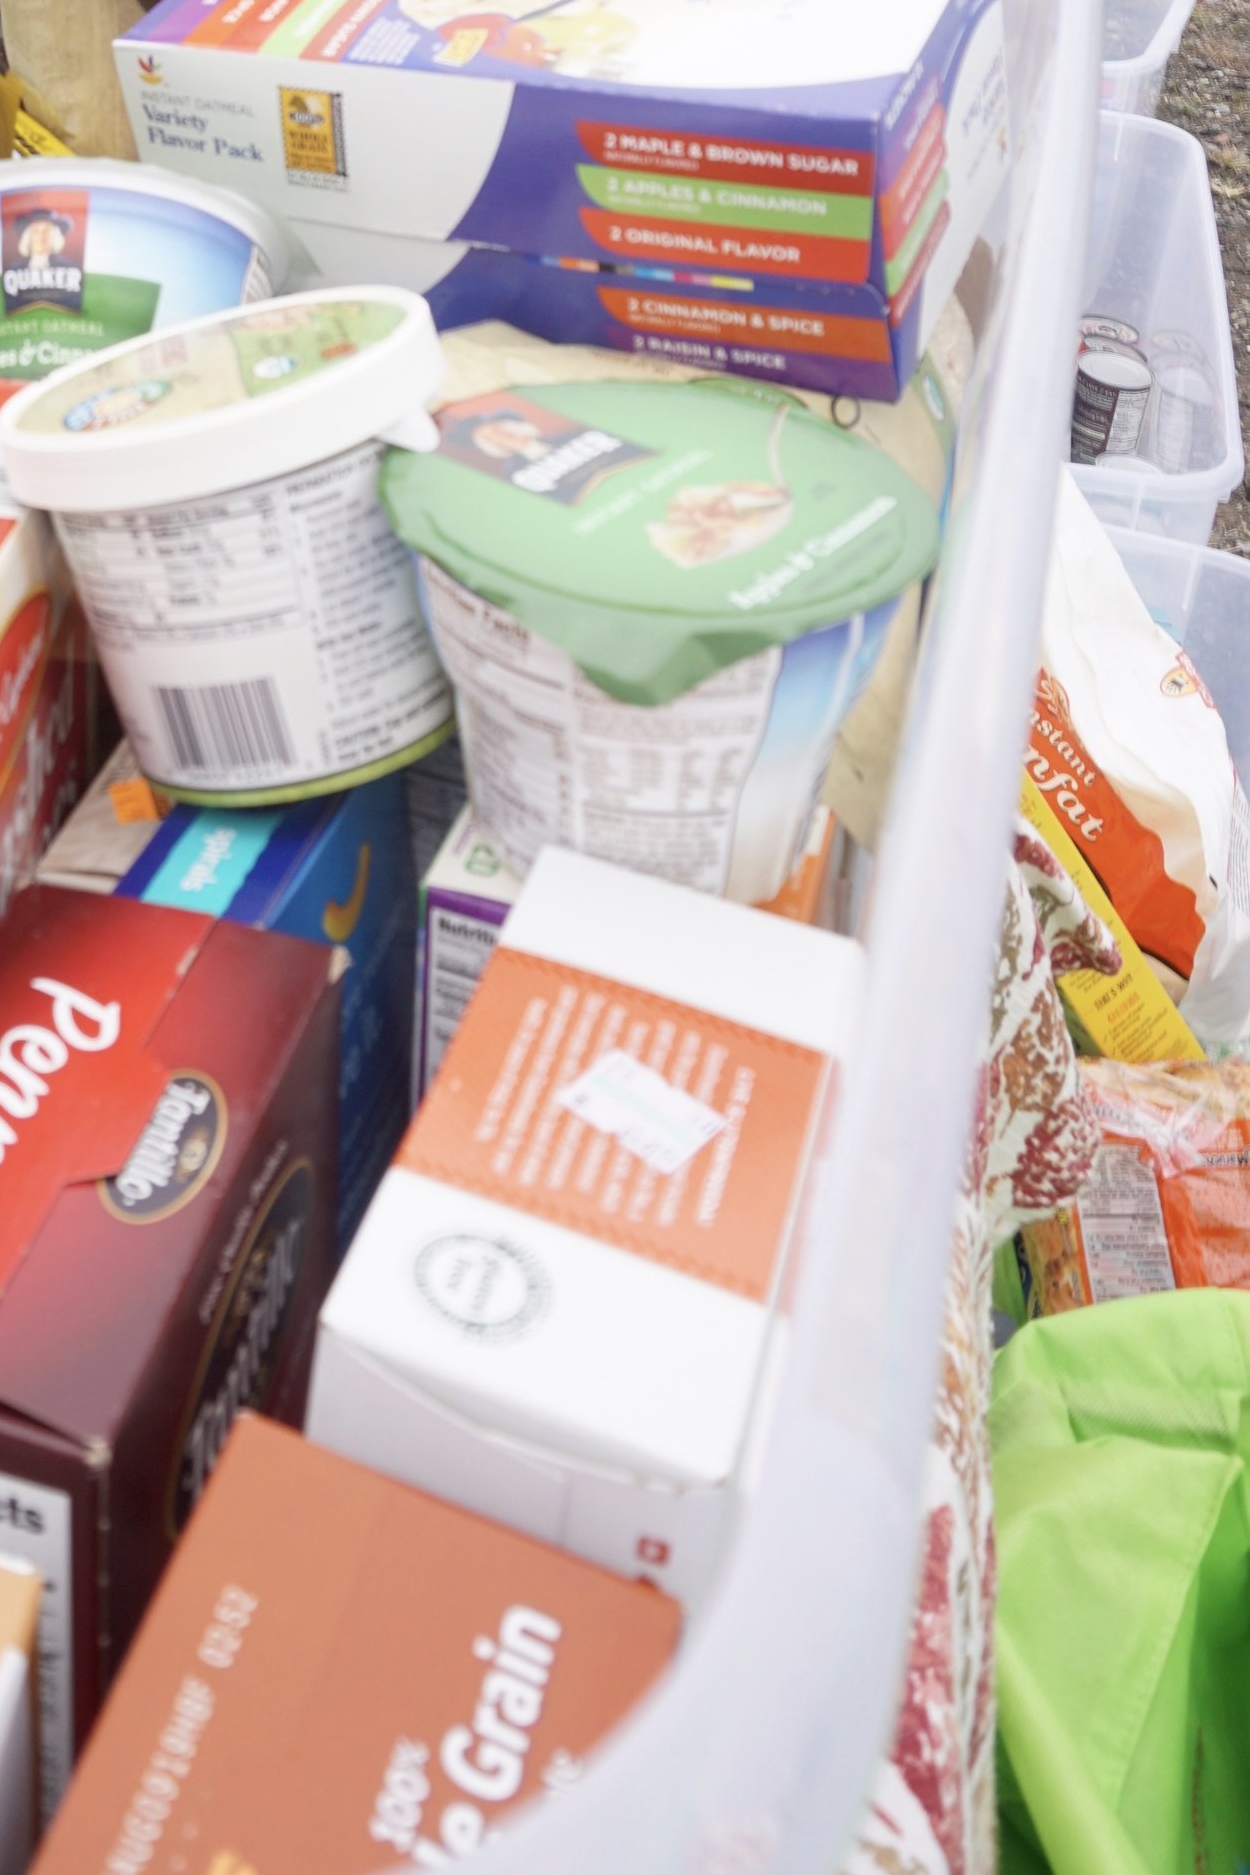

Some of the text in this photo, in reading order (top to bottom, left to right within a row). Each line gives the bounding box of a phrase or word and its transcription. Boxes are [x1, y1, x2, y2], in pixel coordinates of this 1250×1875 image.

[141, 103, 210, 133] Variety
[148, 126, 265, 162] Flavor Pack
[604, 131, 860, 177] 2 MAPLE & BROWN SUGAR
[606, 176, 828, 217] 2 APPLES & CINNAMON
[609, 226, 802, 264] 2 ORIGINAL FLAVOR
[2, 266, 83, 296] QUAKER
[627, 298, 826, 337] 2 CINNAMON & SPICE
[647, 336, 712, 360] RAISIN
[731, 347, 786, 371] SPICE
[440, 1603, 563, 1804] Grain
